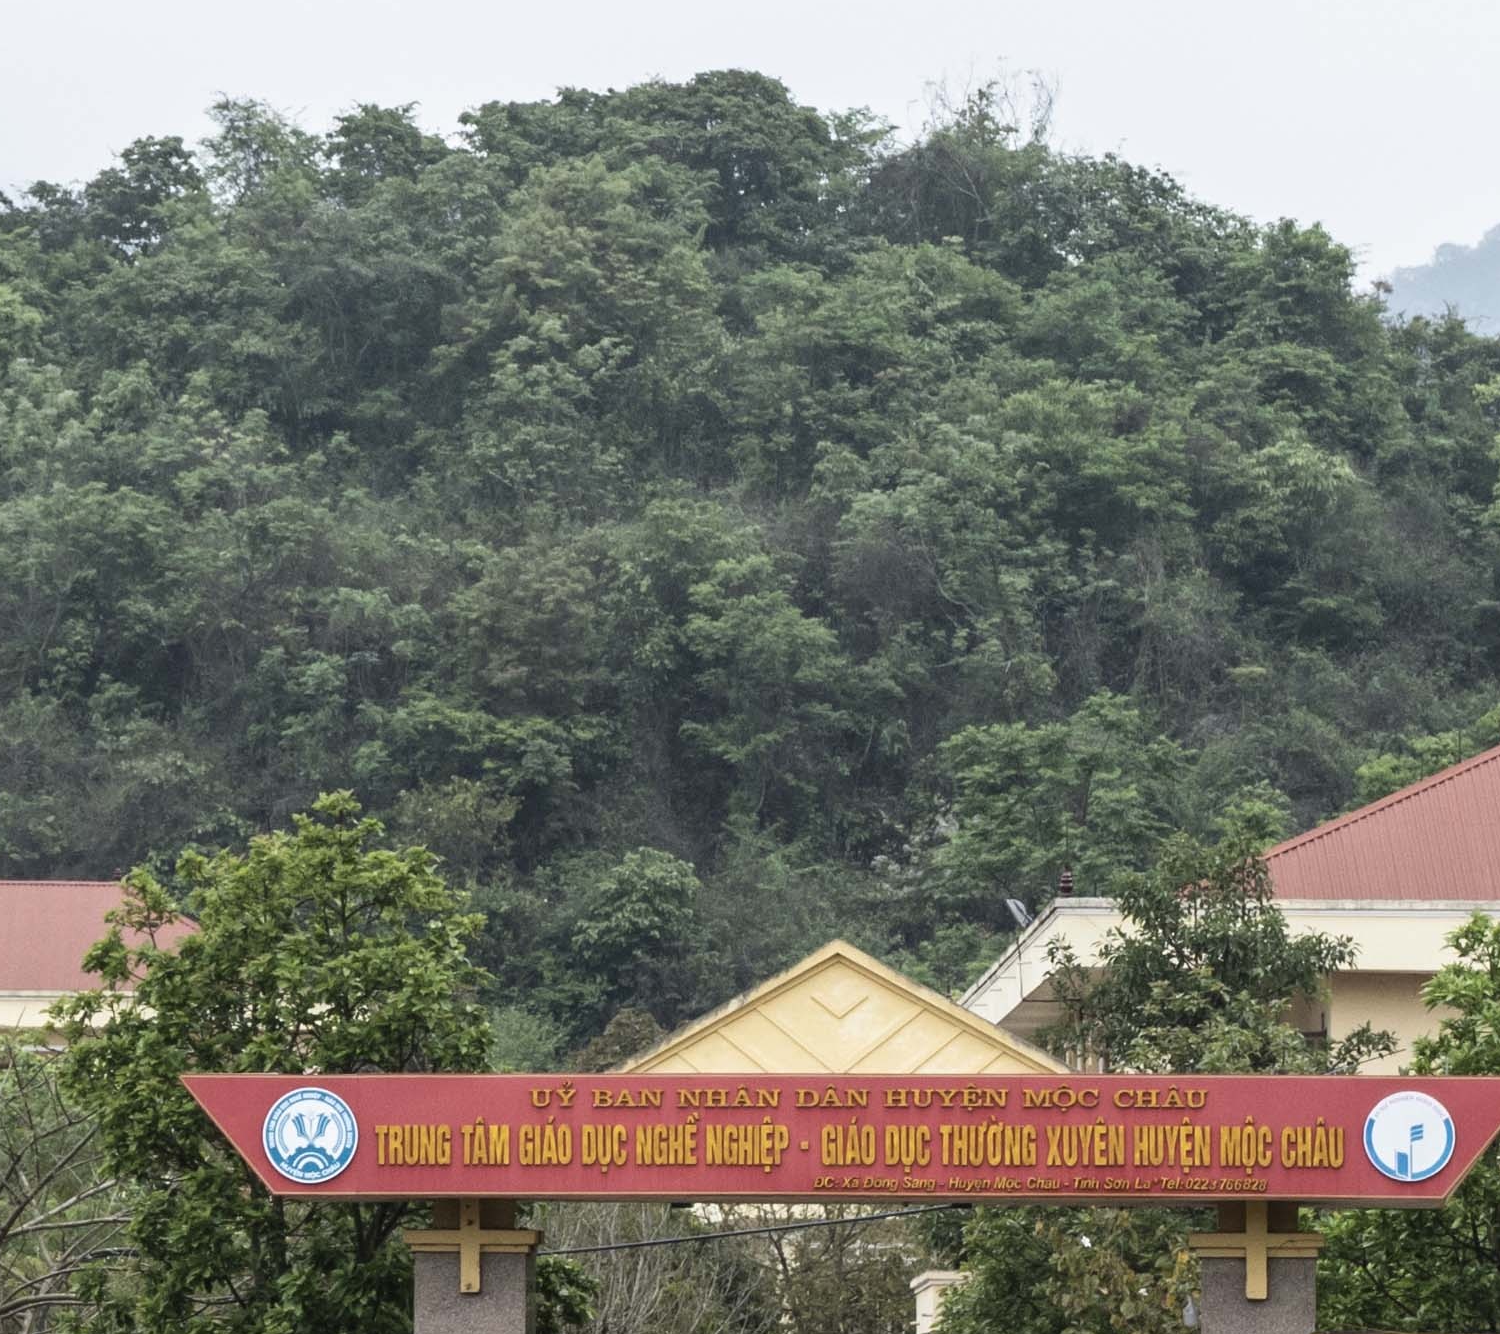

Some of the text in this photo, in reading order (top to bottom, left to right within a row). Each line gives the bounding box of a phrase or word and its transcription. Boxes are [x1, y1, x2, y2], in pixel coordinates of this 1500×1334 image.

[592, 1089, 663, 1107] BAN
[677, 1084, 780, 1107] NHÂN
[795, 1084, 869, 1107] DÂN
[884, 1083, 1008, 1111] HUYỆN
[1023, 1083, 1099, 1111] MỘC
[1113, 1083, 1207, 1108] CHÂU
[375, 1124, 450, 1165] TRUNG
[461, 1116, 510, 1165] TÂM
[519, 1115, 572, 1165] GIÁO
[582, 1124, 627, 1173] DỤC
[636, 1112, 699, 1165] NGHỀ
[706, 1116, 789, 1173] NGHIỆP
[821, 1116, 876, 1165] GIÁO
[885, 1124, 931, 1173] DỤC
[940, 1115, 1037, 1166] THƯỜNG
[1046, 1116, 1125, 1166] XUYÊN
[1133, 1116, 1211, 1174] HUYỆN
[1220, 1115, 1273, 1174] MỘC
[1281, 1116, 1344, 1168] CHÂU
